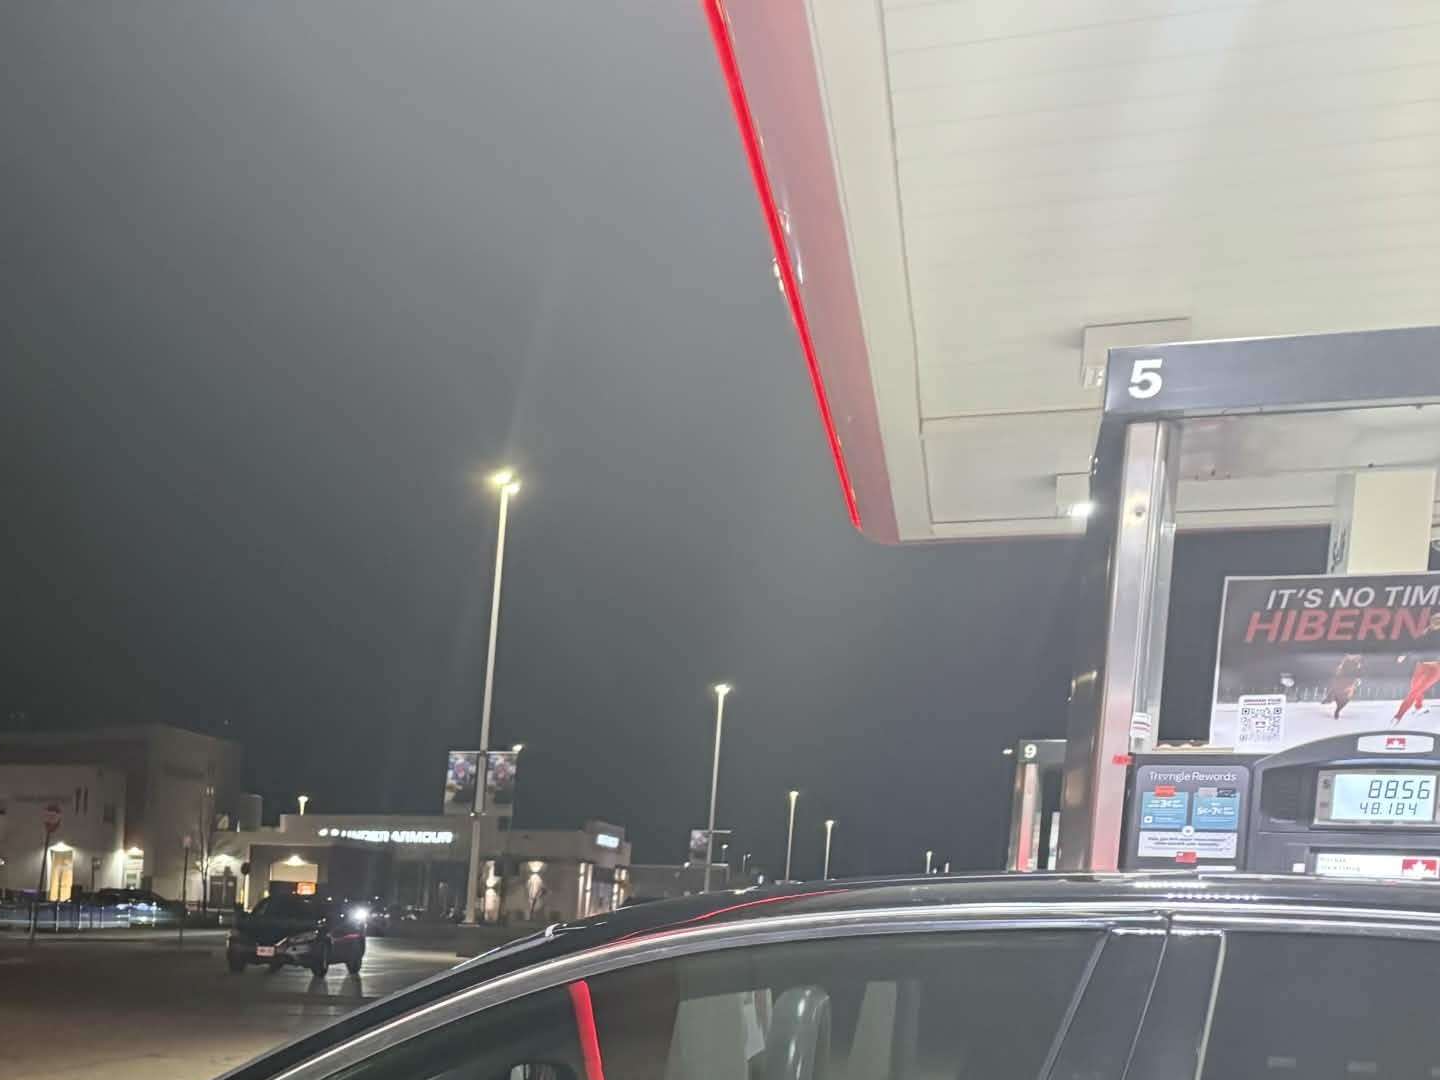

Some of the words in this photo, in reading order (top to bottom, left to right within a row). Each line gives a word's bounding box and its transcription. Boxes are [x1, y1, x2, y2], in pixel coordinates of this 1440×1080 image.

[1127, 358, 1163, 399] 5
[1266, 587, 1324, 610] IT'S
[1328, 586, 1375, 608] NO
[1384, 584, 1440, 607] TIM
[1244, 607, 1431, 642] HIBERN
[1024, 743, 1037, 759] 9
[1191, 771, 1238, 782] Rewards
